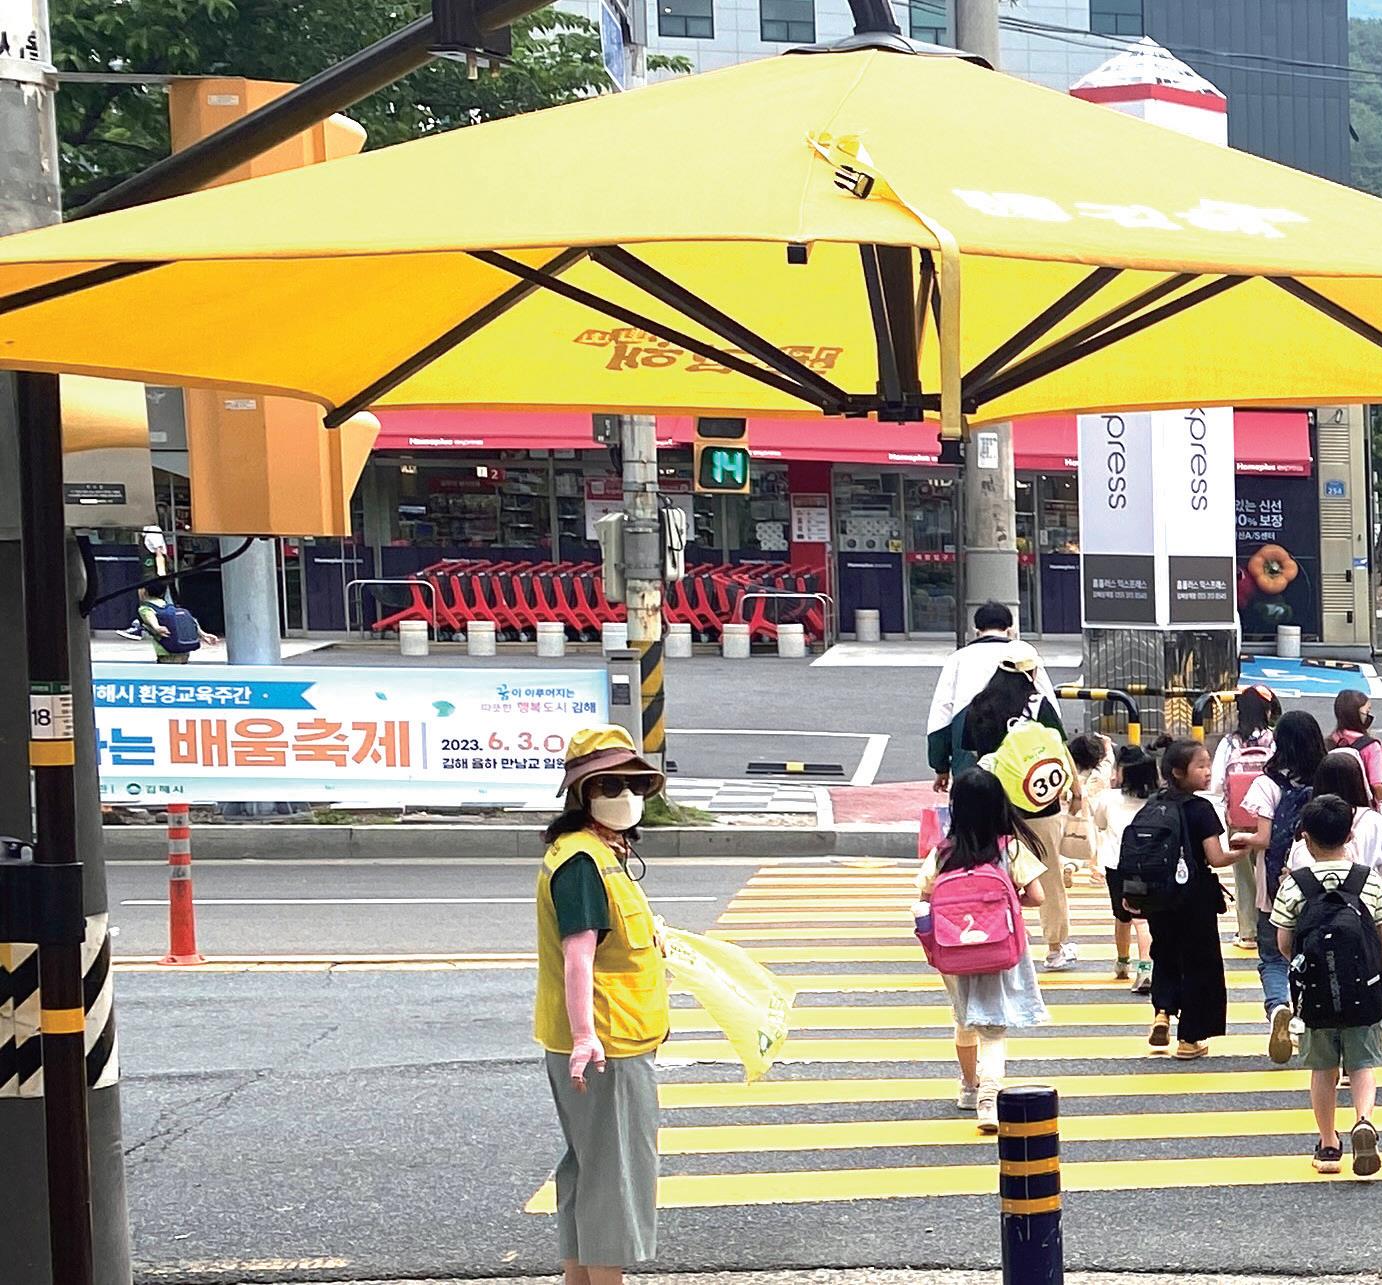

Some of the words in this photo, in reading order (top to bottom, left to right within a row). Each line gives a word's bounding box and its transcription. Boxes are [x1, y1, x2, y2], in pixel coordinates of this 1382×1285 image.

[712, 450, 743, 484] 14
[1236, 462, 1276, 472] Homeplus
[1259, 499, 1283, 513] 신선
[1235, 514, 1258, 526] 0%
[1260, 514, 1283, 528] 보장
[93, 684, 134, 704] 해시
[138, 684, 252, 705] 환경교육주간
[496, 683, 522, 701] 꿈이
[524, 687, 575, 699] 이루어지는
[517, 701, 567, 713] 행복도시
[571, 701, 597, 713] 김해
[31, 708, 51, 726] 18
[168, 717, 411, 768] 배움축제
[441, 739, 484, 752] 2023.
[488, 731, 510, 752] 6.
[517, 731, 540, 752] 3.
[442, 757, 468, 770] 김해
[471, 757, 498, 770] 율하
[500, 757, 541, 770] 만남교
[145, 784, 185, 795] 김해시
[1032, 769, 1063, 797] 30
